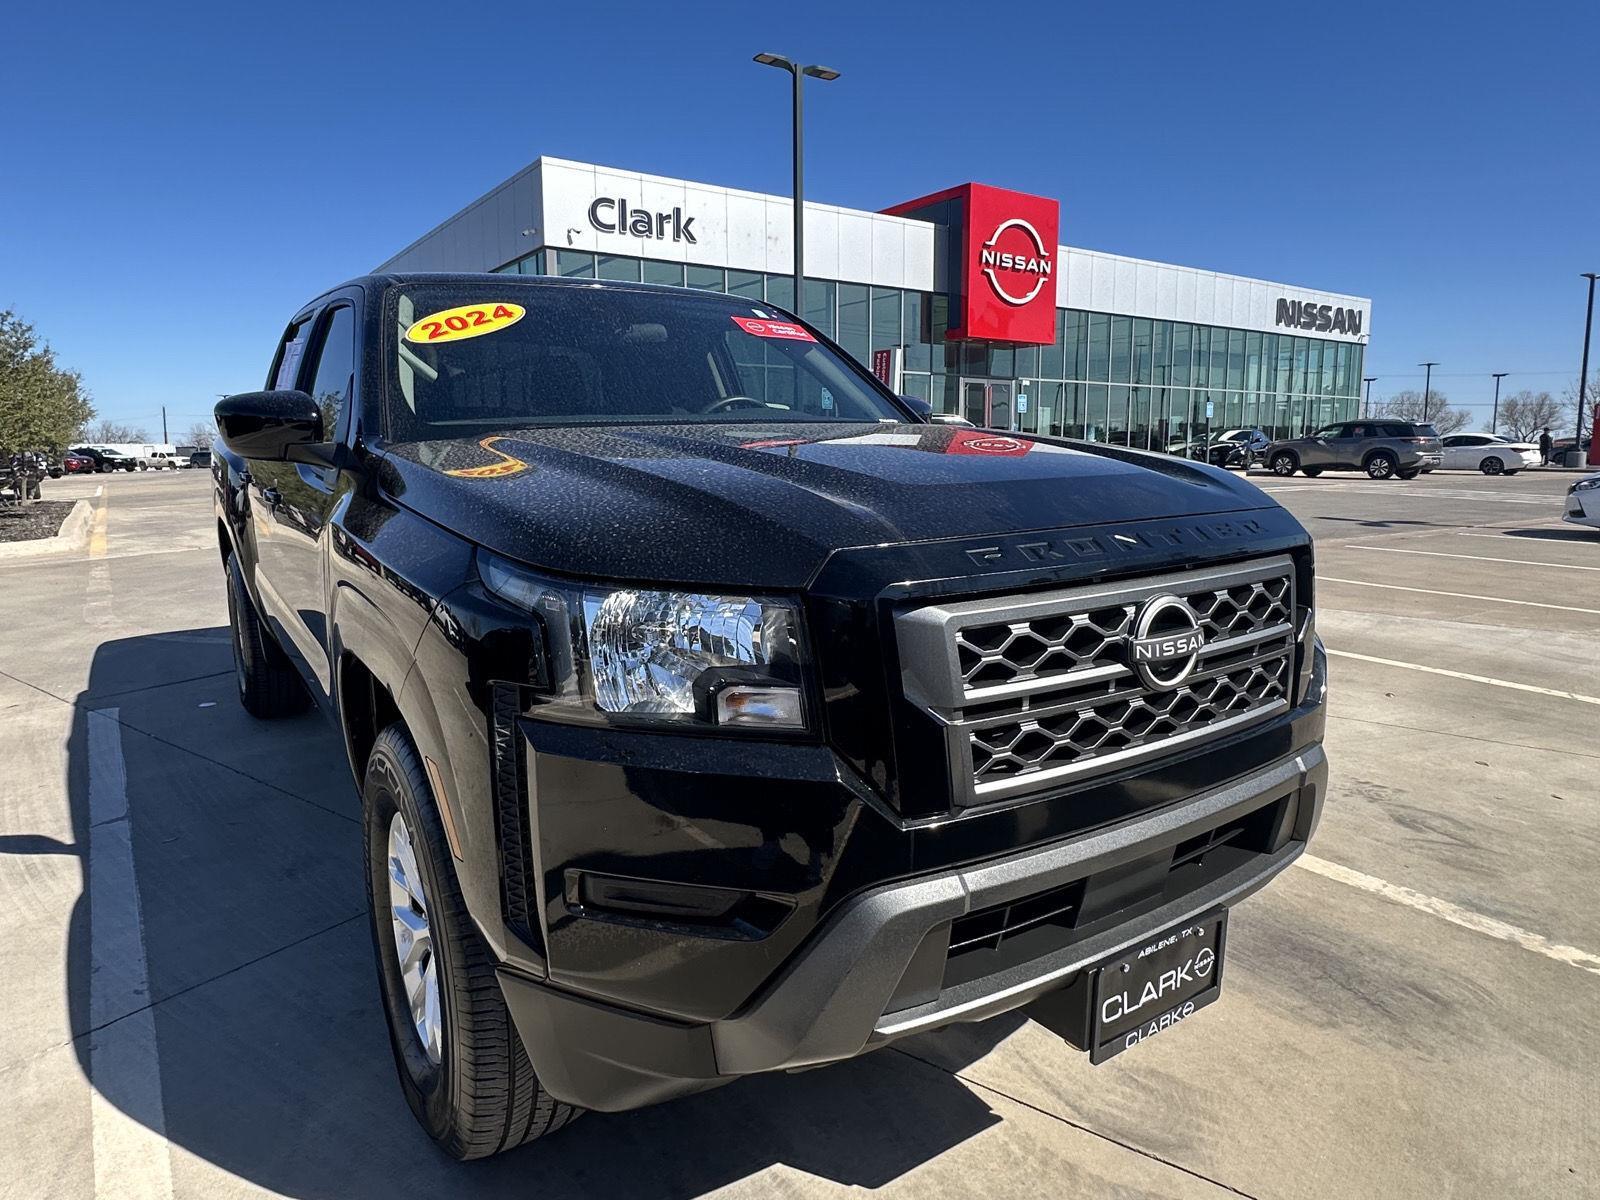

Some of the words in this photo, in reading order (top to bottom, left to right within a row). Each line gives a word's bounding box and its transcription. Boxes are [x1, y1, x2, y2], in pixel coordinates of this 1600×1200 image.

[588, 197, 697, 244] Clark
[981, 249, 1052, 274] NISSAN
[421, 305, 515, 340] 2024
[1275, 298, 1362, 335] NISSAN
[966, 519, 1269, 567] FRONTIER
[1136, 633, 1205, 659] NISSAN
[1181, 926, 1193, 938] TX
[1102, 959, 1193, 1023] CLARK
[1125, 1006, 1182, 1049] CLARK
